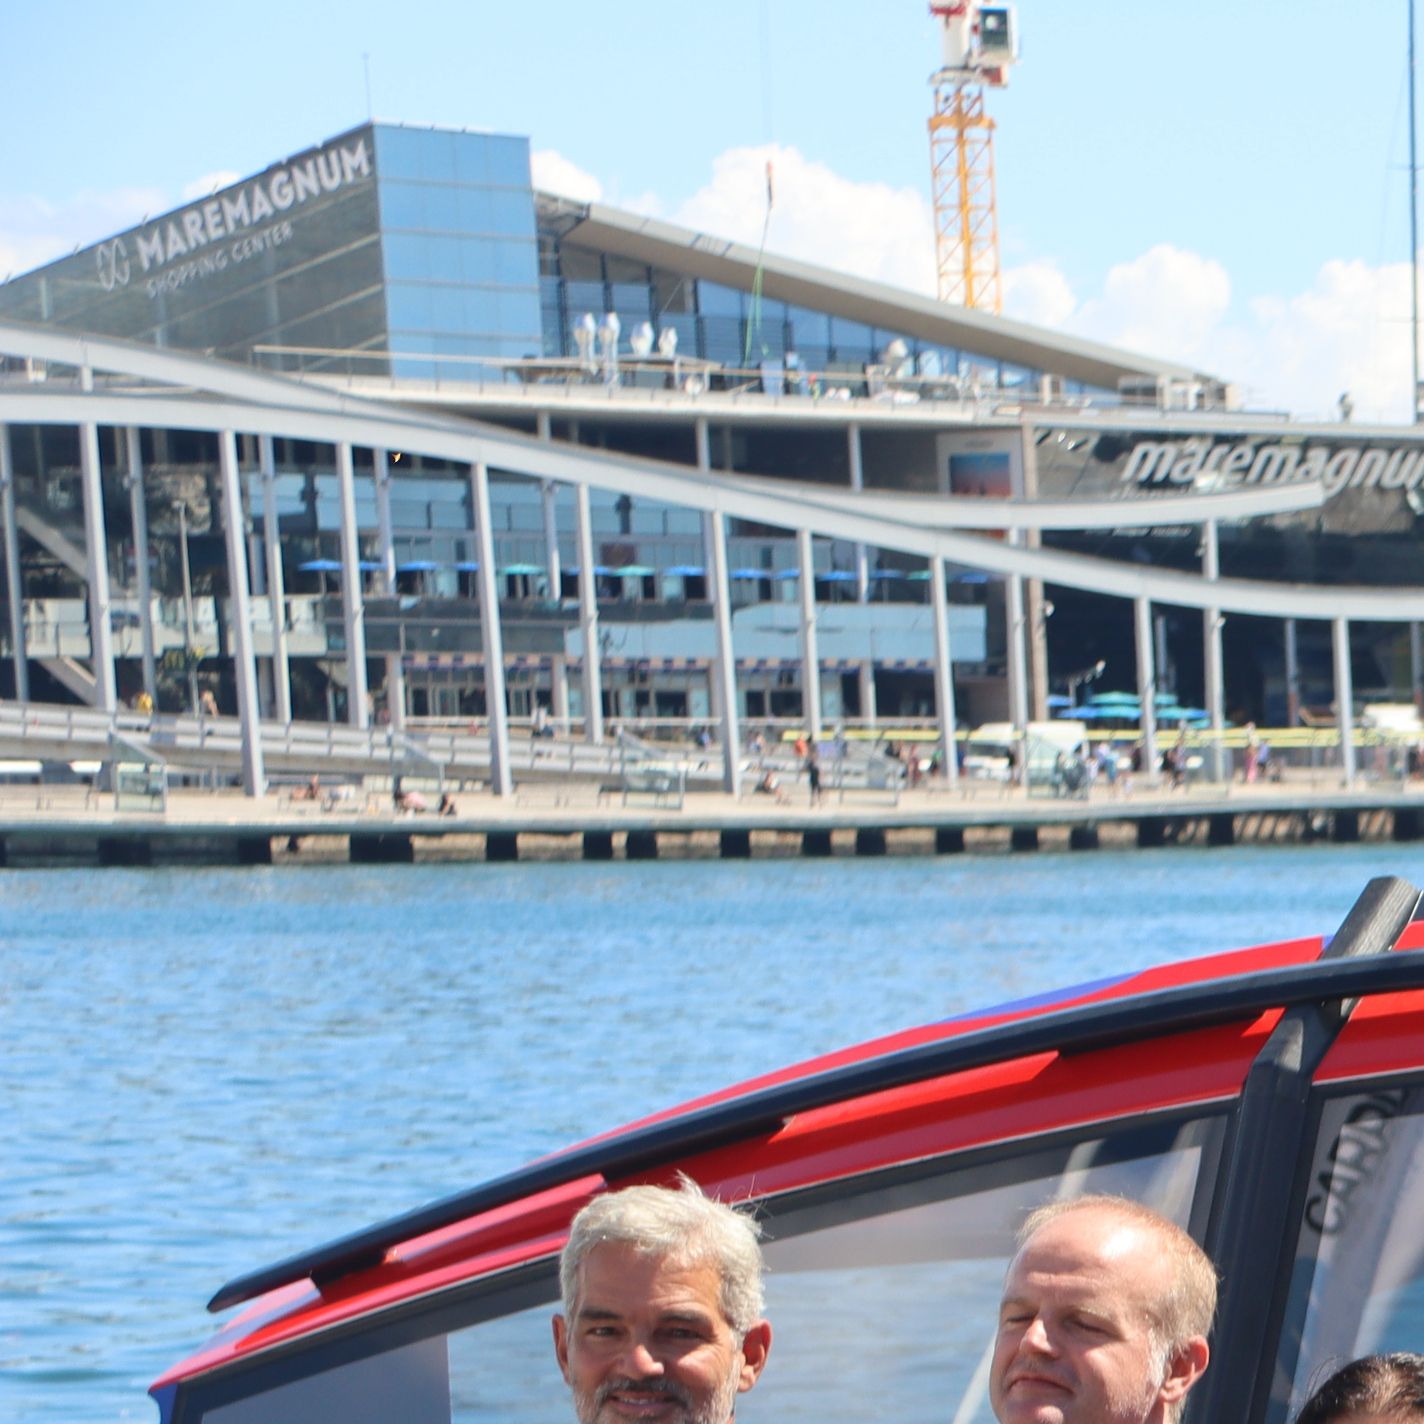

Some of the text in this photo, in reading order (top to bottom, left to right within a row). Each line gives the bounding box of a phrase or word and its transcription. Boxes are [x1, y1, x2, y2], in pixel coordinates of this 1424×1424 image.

[136, 137, 372, 273] MAREMAGNUM
[146, 220, 295, 299] SHOPPING CENTER
